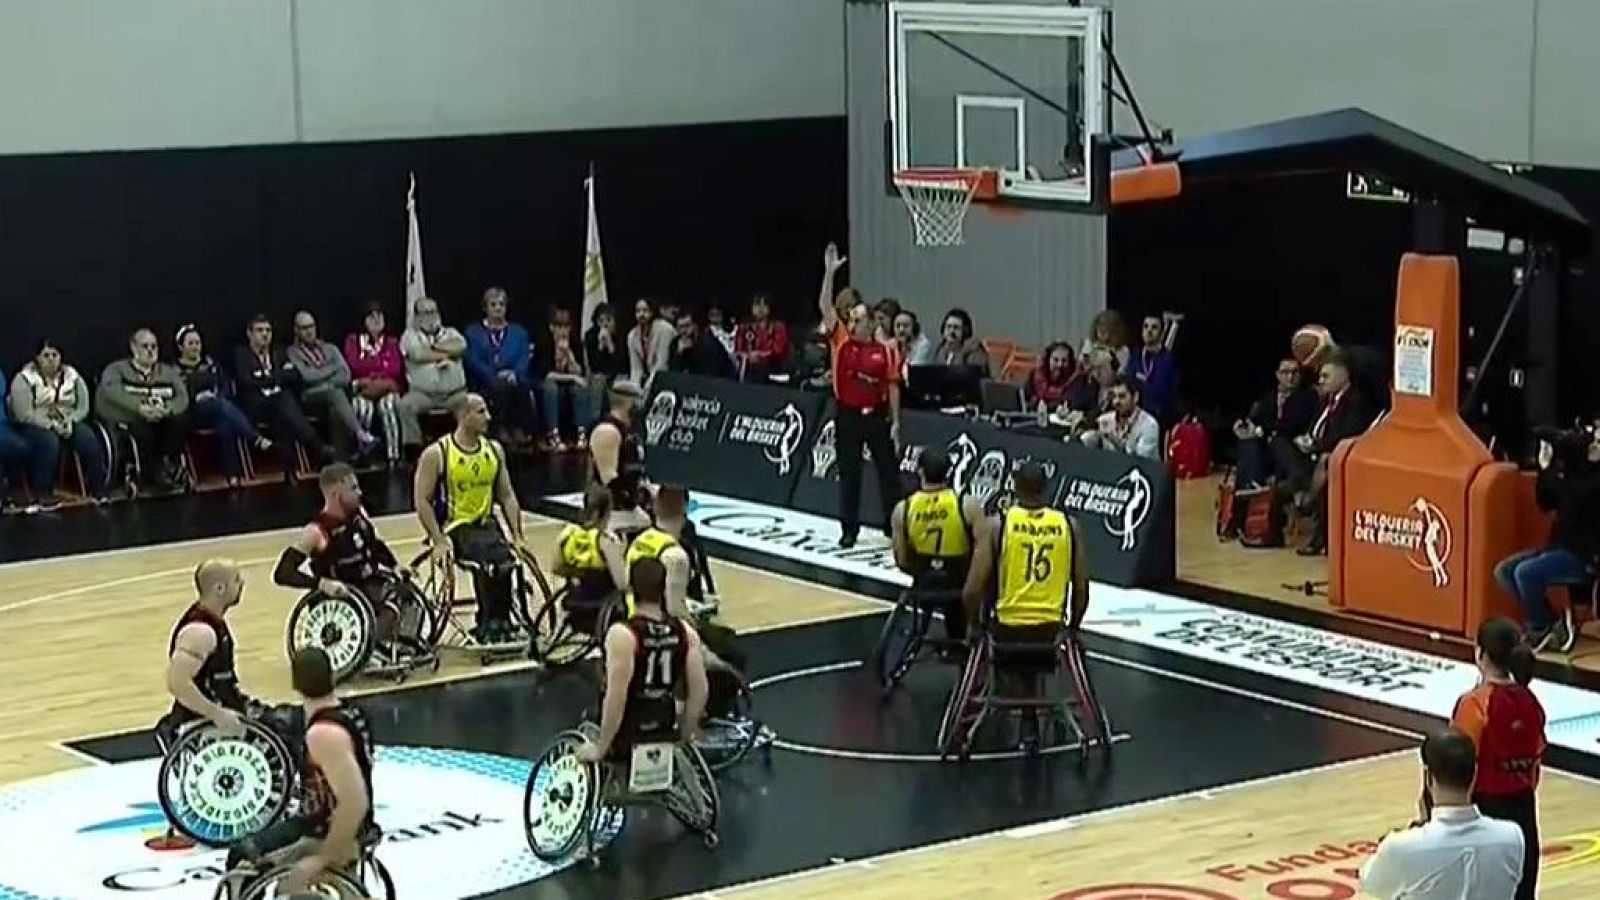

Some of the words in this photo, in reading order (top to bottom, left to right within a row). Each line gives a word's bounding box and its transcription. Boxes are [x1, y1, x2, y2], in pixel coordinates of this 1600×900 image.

[1084, 500, 1123, 517] BASKET
[1355, 526, 1375, 543] DEL
[1378, 529, 1421, 549] BASKET
[645, 649, 672, 684] 11
